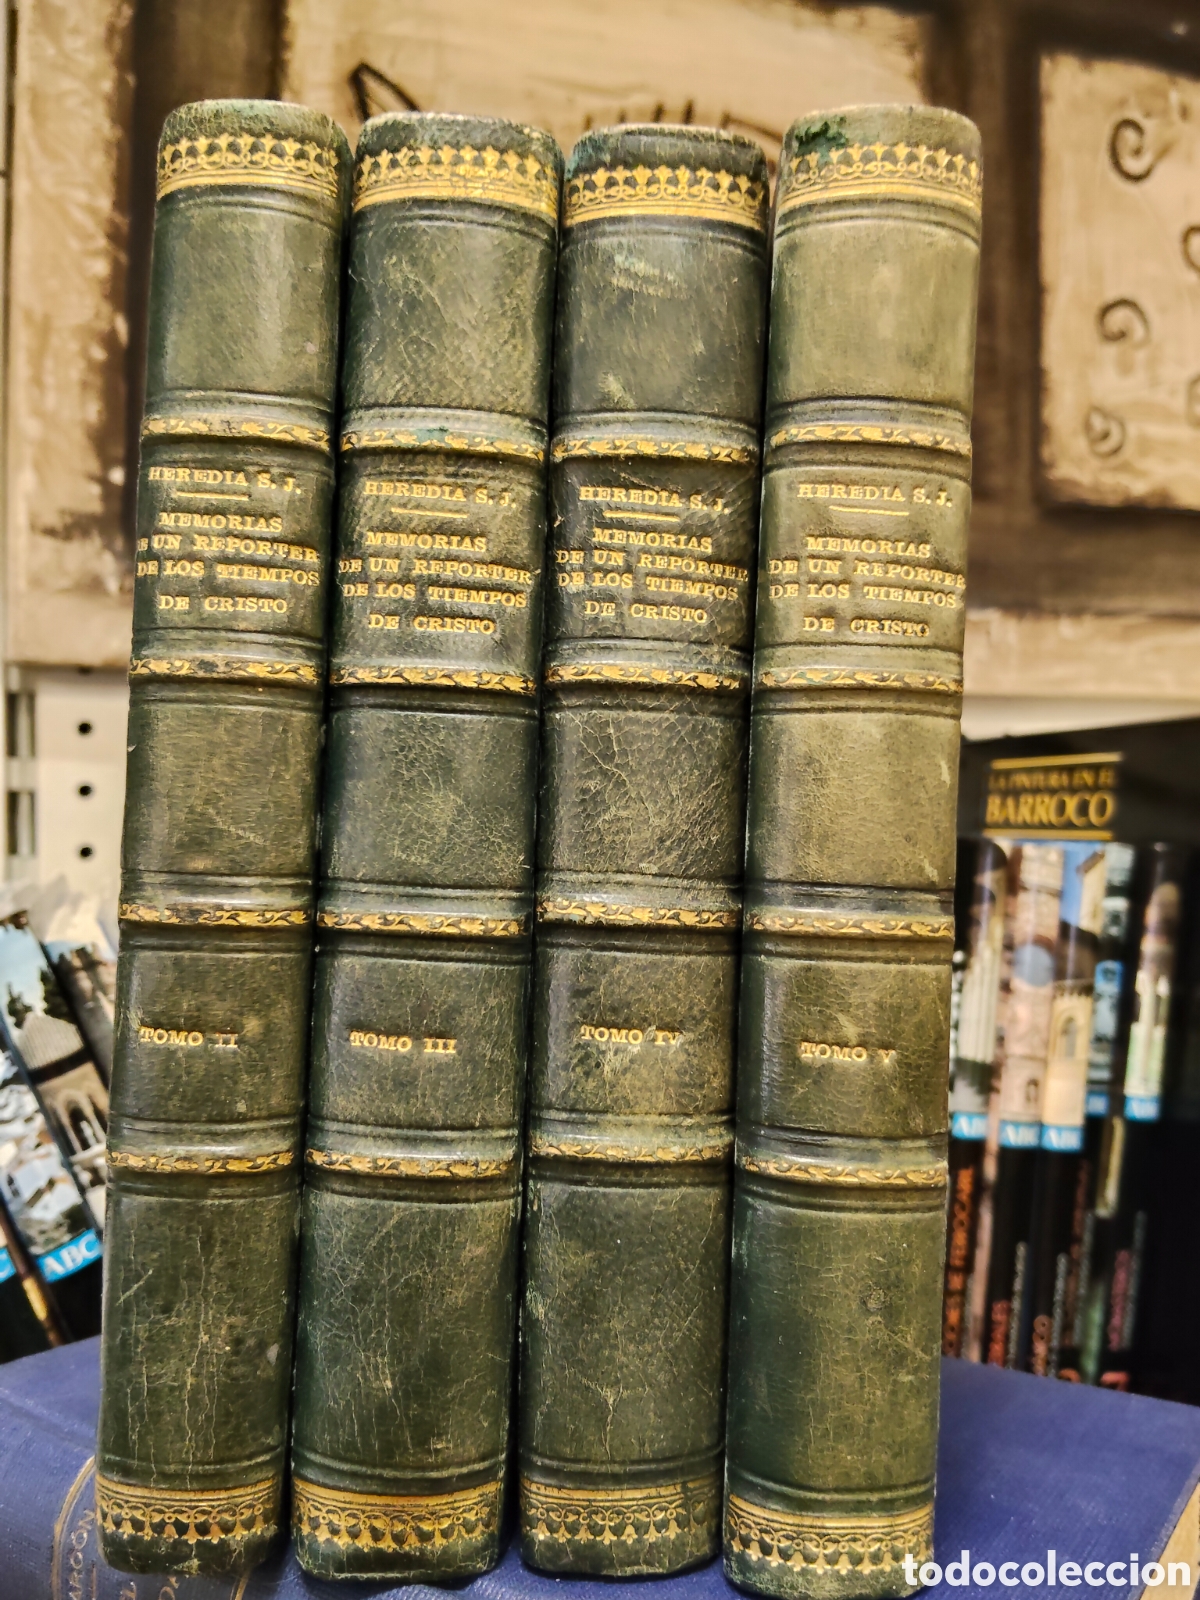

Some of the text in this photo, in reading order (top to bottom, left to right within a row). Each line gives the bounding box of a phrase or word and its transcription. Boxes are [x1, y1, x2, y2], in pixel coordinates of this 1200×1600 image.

[148, 467, 301, 495] HEREDIA S. J.
[364, 481, 518, 509] HEREDIA S. J.
[579, 486, 730, 515] HEREDIA S. J.
[797, 483, 953, 508] HEREDIA S. J.
[159, 511, 282, 533] MEMORIAS
[152, 533, 182, 550] UN
[193, 533, 320, 563] REPORTER
[366, 531, 487, 552] MEMORIAS
[593, 528, 713, 553] MEMORIAS
[806, 536, 931, 558] MEMORIAS
[136, 559, 320, 587] DE LOS TIEMPOS
[339, 557, 532, 585] DE UN REPORTER
[556, 550, 749, 582] DE UN REPORTER
[769, 559, 967, 590] DE UN REPORTER
[344, 582, 527, 608] DE LOS TIEMPOS
[558, 571, 739, 601] DE LOS TIEMPOS
[770, 582, 957, 609] DE LOS TIEMPOS
[159, 595, 289, 614] DE CRISTO
[585, 600, 708, 624] DE CRISTO
[368, 613, 496, 635] DE CRISTO
[803, 616, 930, 637] DE CRISTO
[986, 791, 1116, 827] BARROCO
[138, 1025, 239, 1048] TOMO II
[351, 1030, 457, 1054] TOMO III
[581, 1024, 681, 1046] TOMO IV
[801, 1041, 896, 1063] TOMO V
[44, 1233, 98, 1277] ABC
